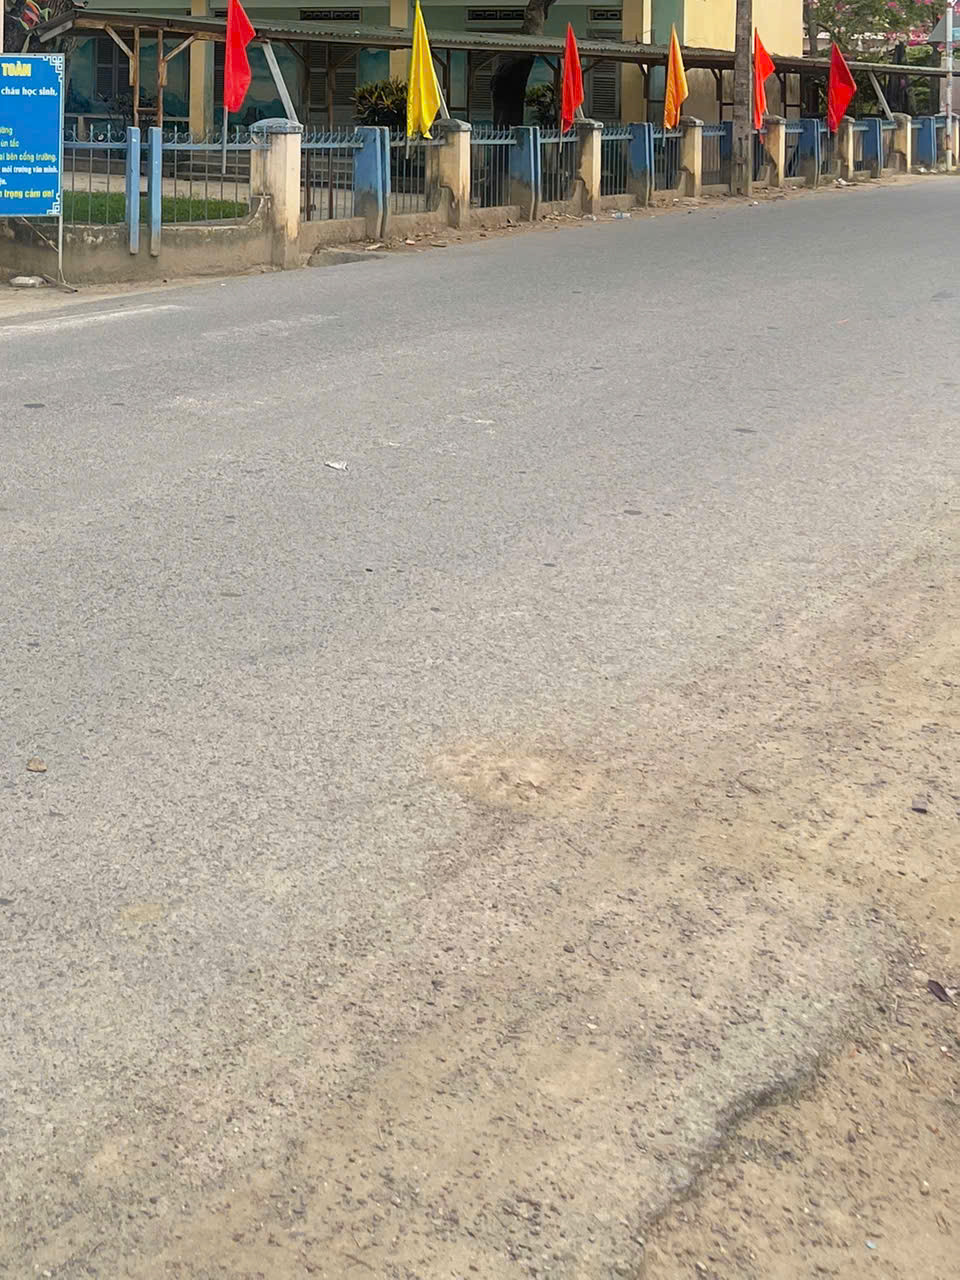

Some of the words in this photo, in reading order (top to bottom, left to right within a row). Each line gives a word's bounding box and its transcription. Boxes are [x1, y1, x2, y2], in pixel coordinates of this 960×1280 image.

[1, 60, 32, 77] TOÀN
[0, 86, 20, 95] cháu
[22, 87, 37, 97] học
[4, 189, 23, 199] trọng
